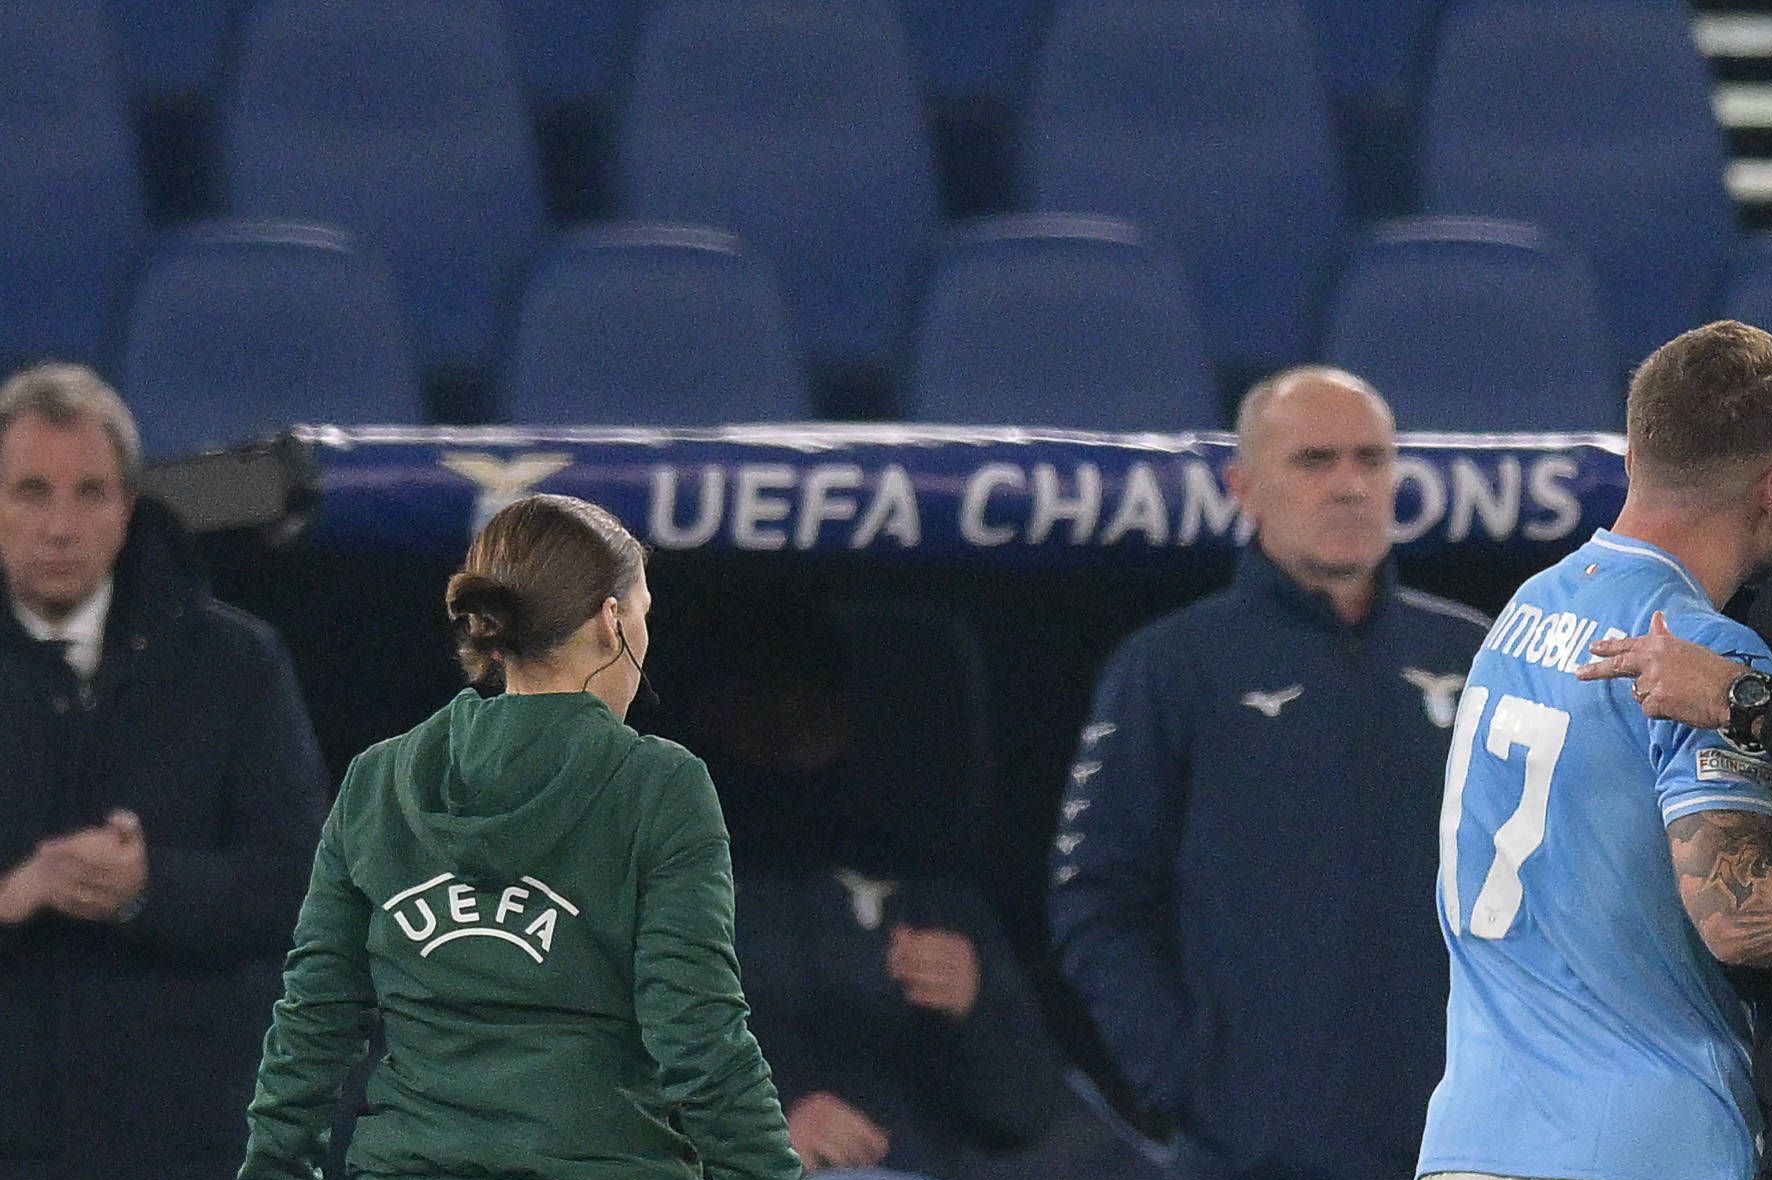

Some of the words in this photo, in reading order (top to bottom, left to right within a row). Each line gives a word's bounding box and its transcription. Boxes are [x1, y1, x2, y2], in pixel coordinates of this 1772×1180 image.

[651, 463, 921, 550] UEFA
[959, 457, 1582, 547] CHAMONS
[1437, 686, 1571, 940] 17
[393, 883, 558, 952] UEFA
